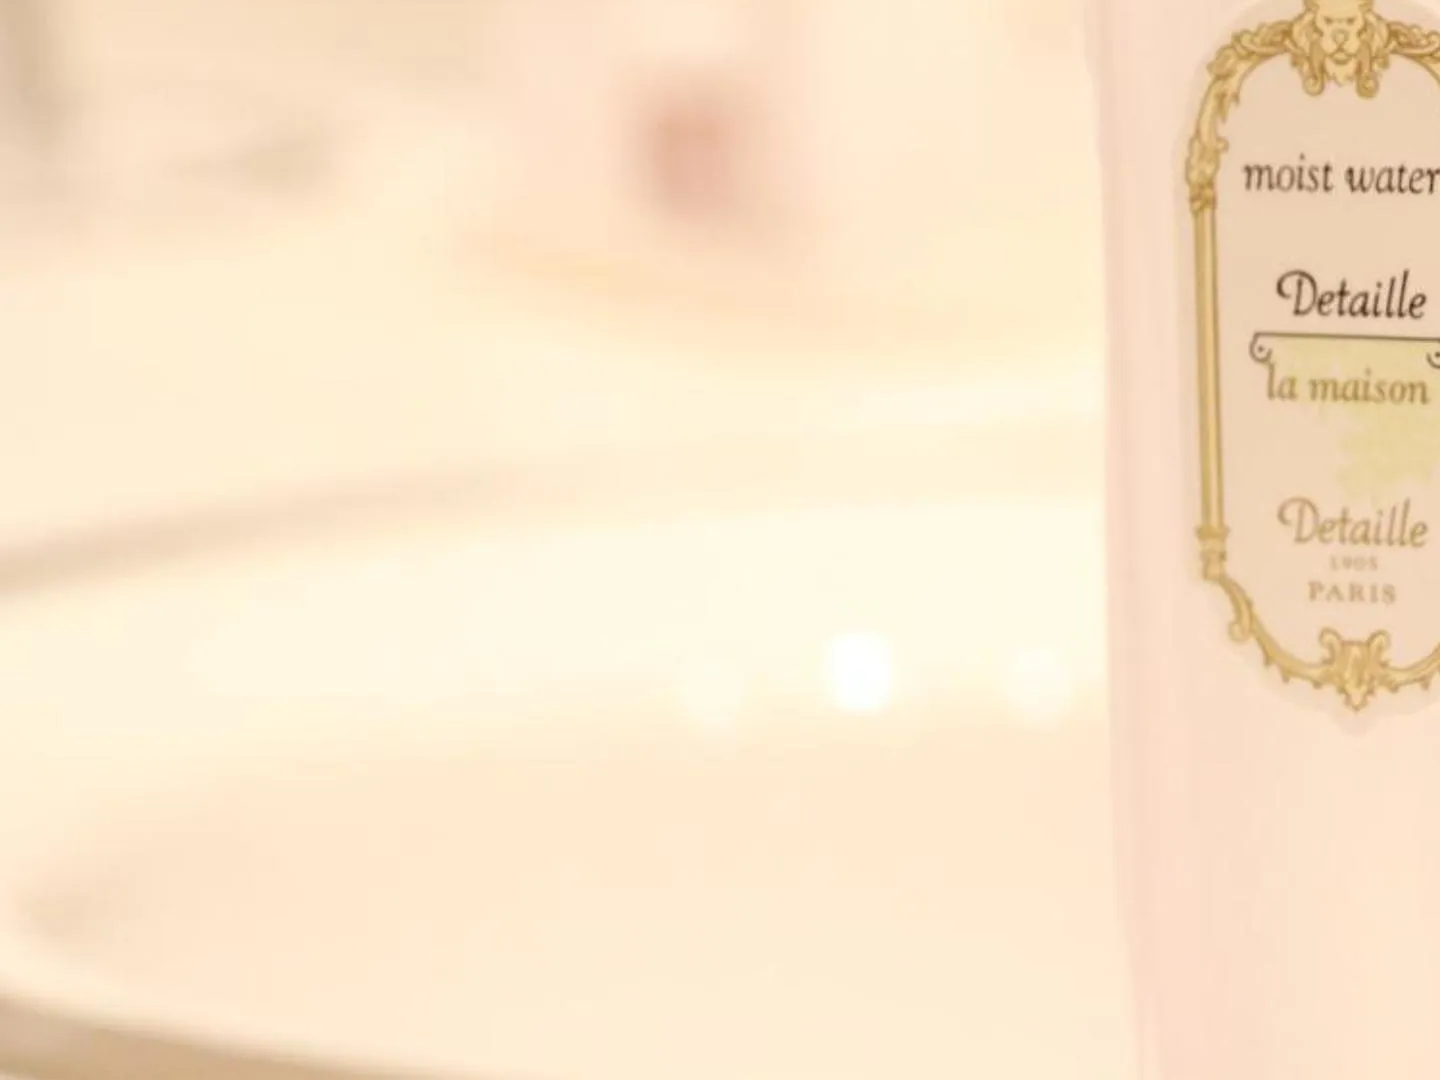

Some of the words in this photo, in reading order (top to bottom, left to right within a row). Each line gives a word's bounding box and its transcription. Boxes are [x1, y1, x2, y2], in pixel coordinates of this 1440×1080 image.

[1242, 153, 1334, 193] moist
[1276, 268, 1428, 320] Detaille
[1266, 362, 1298, 402] la
[1308, 367, 1431, 406] maison
[1277, 496, 1429, 549] Detaille
[1307, 580, 1397, 606] PARIS
